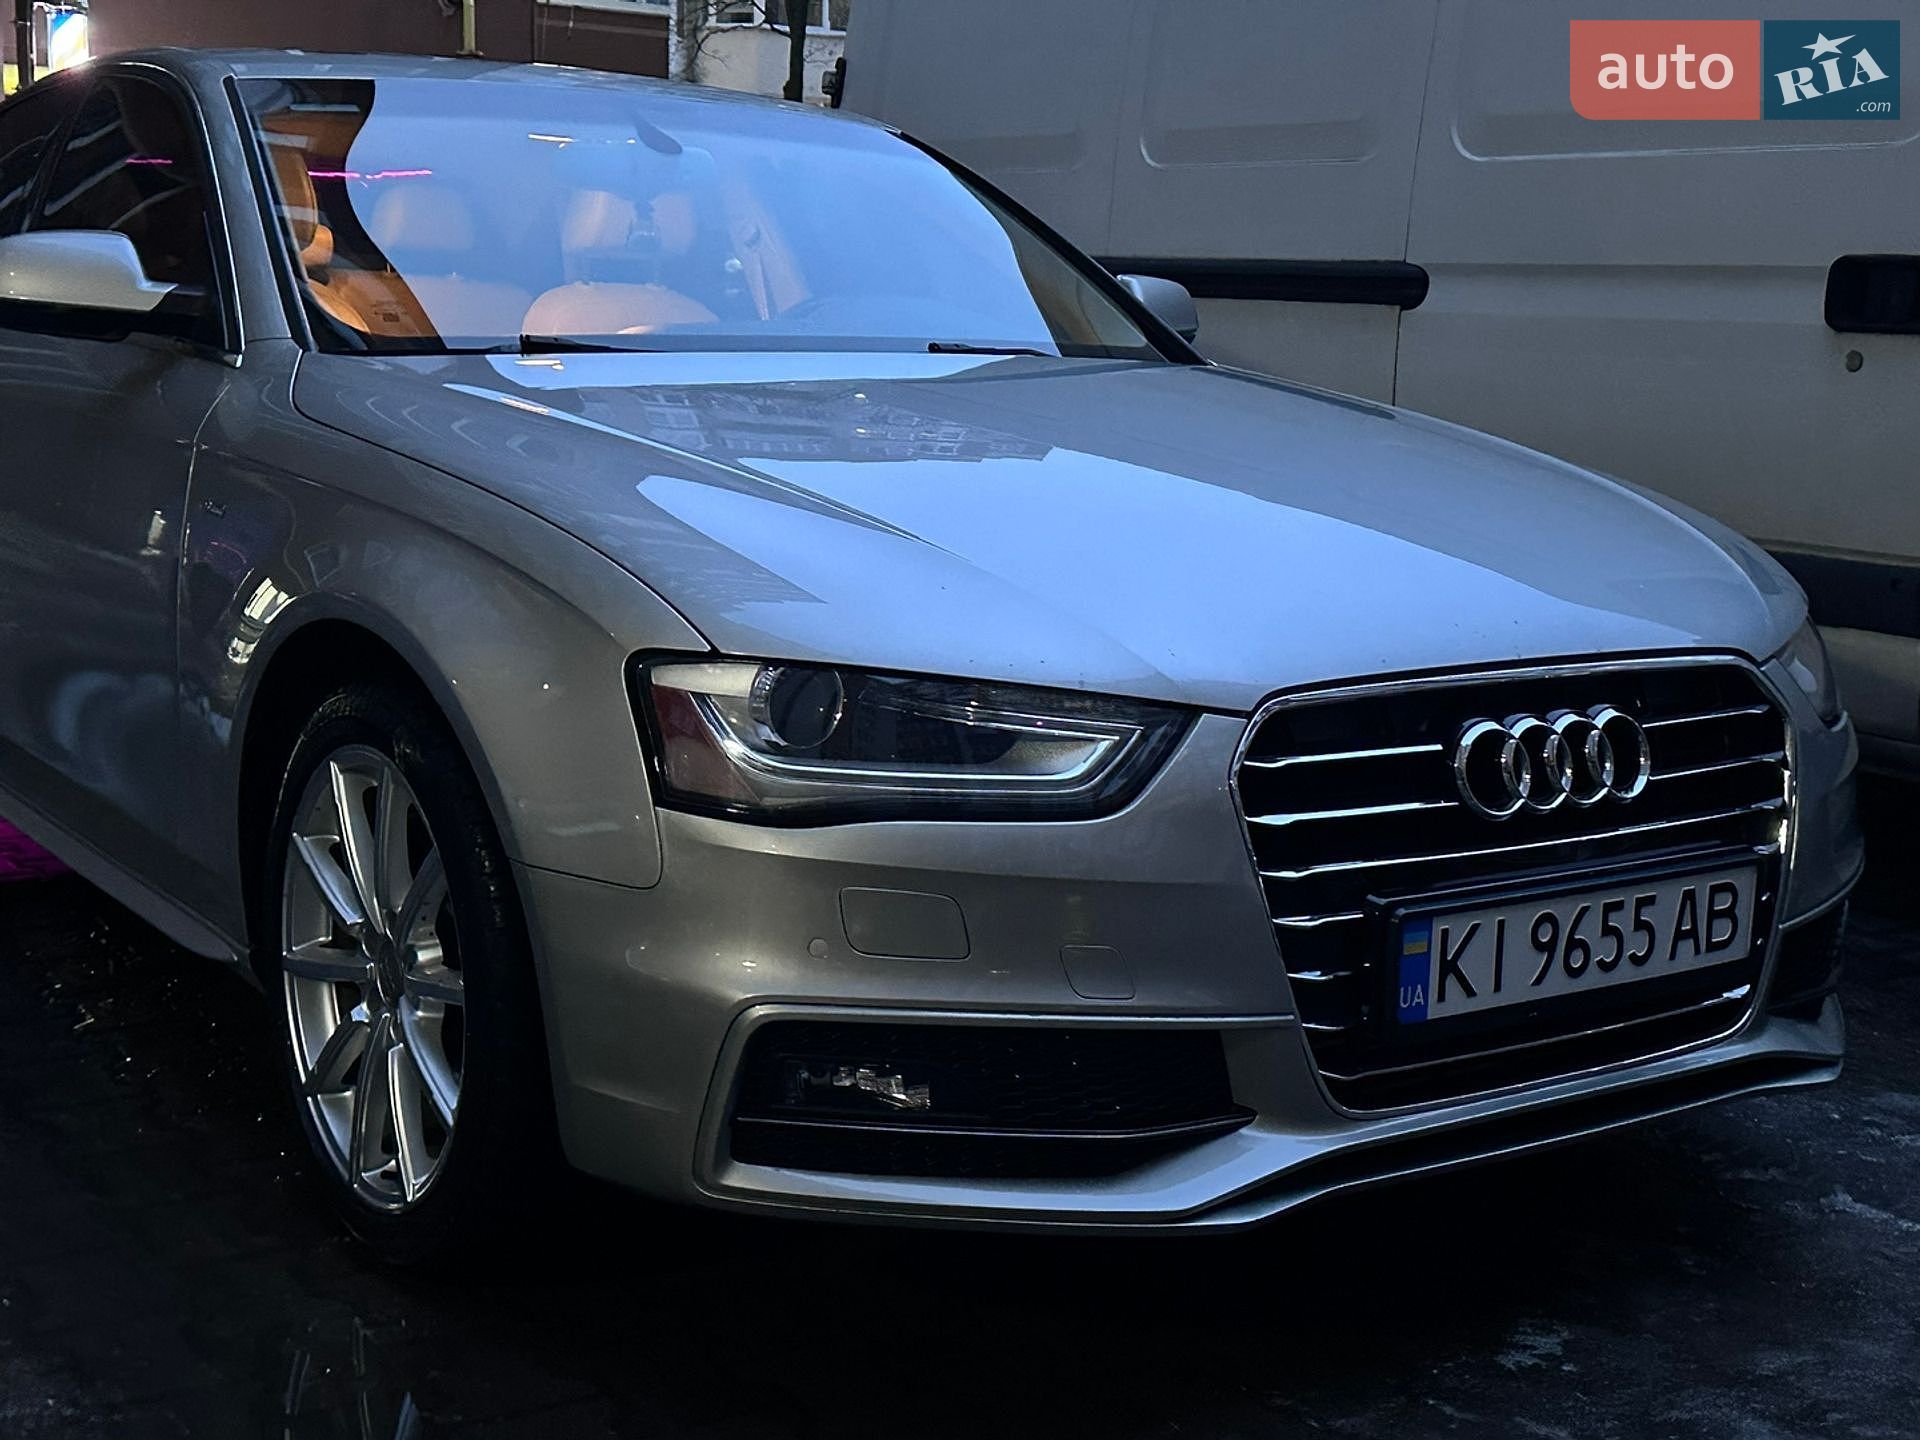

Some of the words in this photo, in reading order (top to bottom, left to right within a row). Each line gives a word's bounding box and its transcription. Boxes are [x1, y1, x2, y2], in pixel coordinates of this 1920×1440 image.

[1437, 917, 1506, 1003] KI
[1530, 893, 1658, 987] 9655
[1669, 880, 1739, 961] AB
[1400, 984, 1424, 1008] UA
